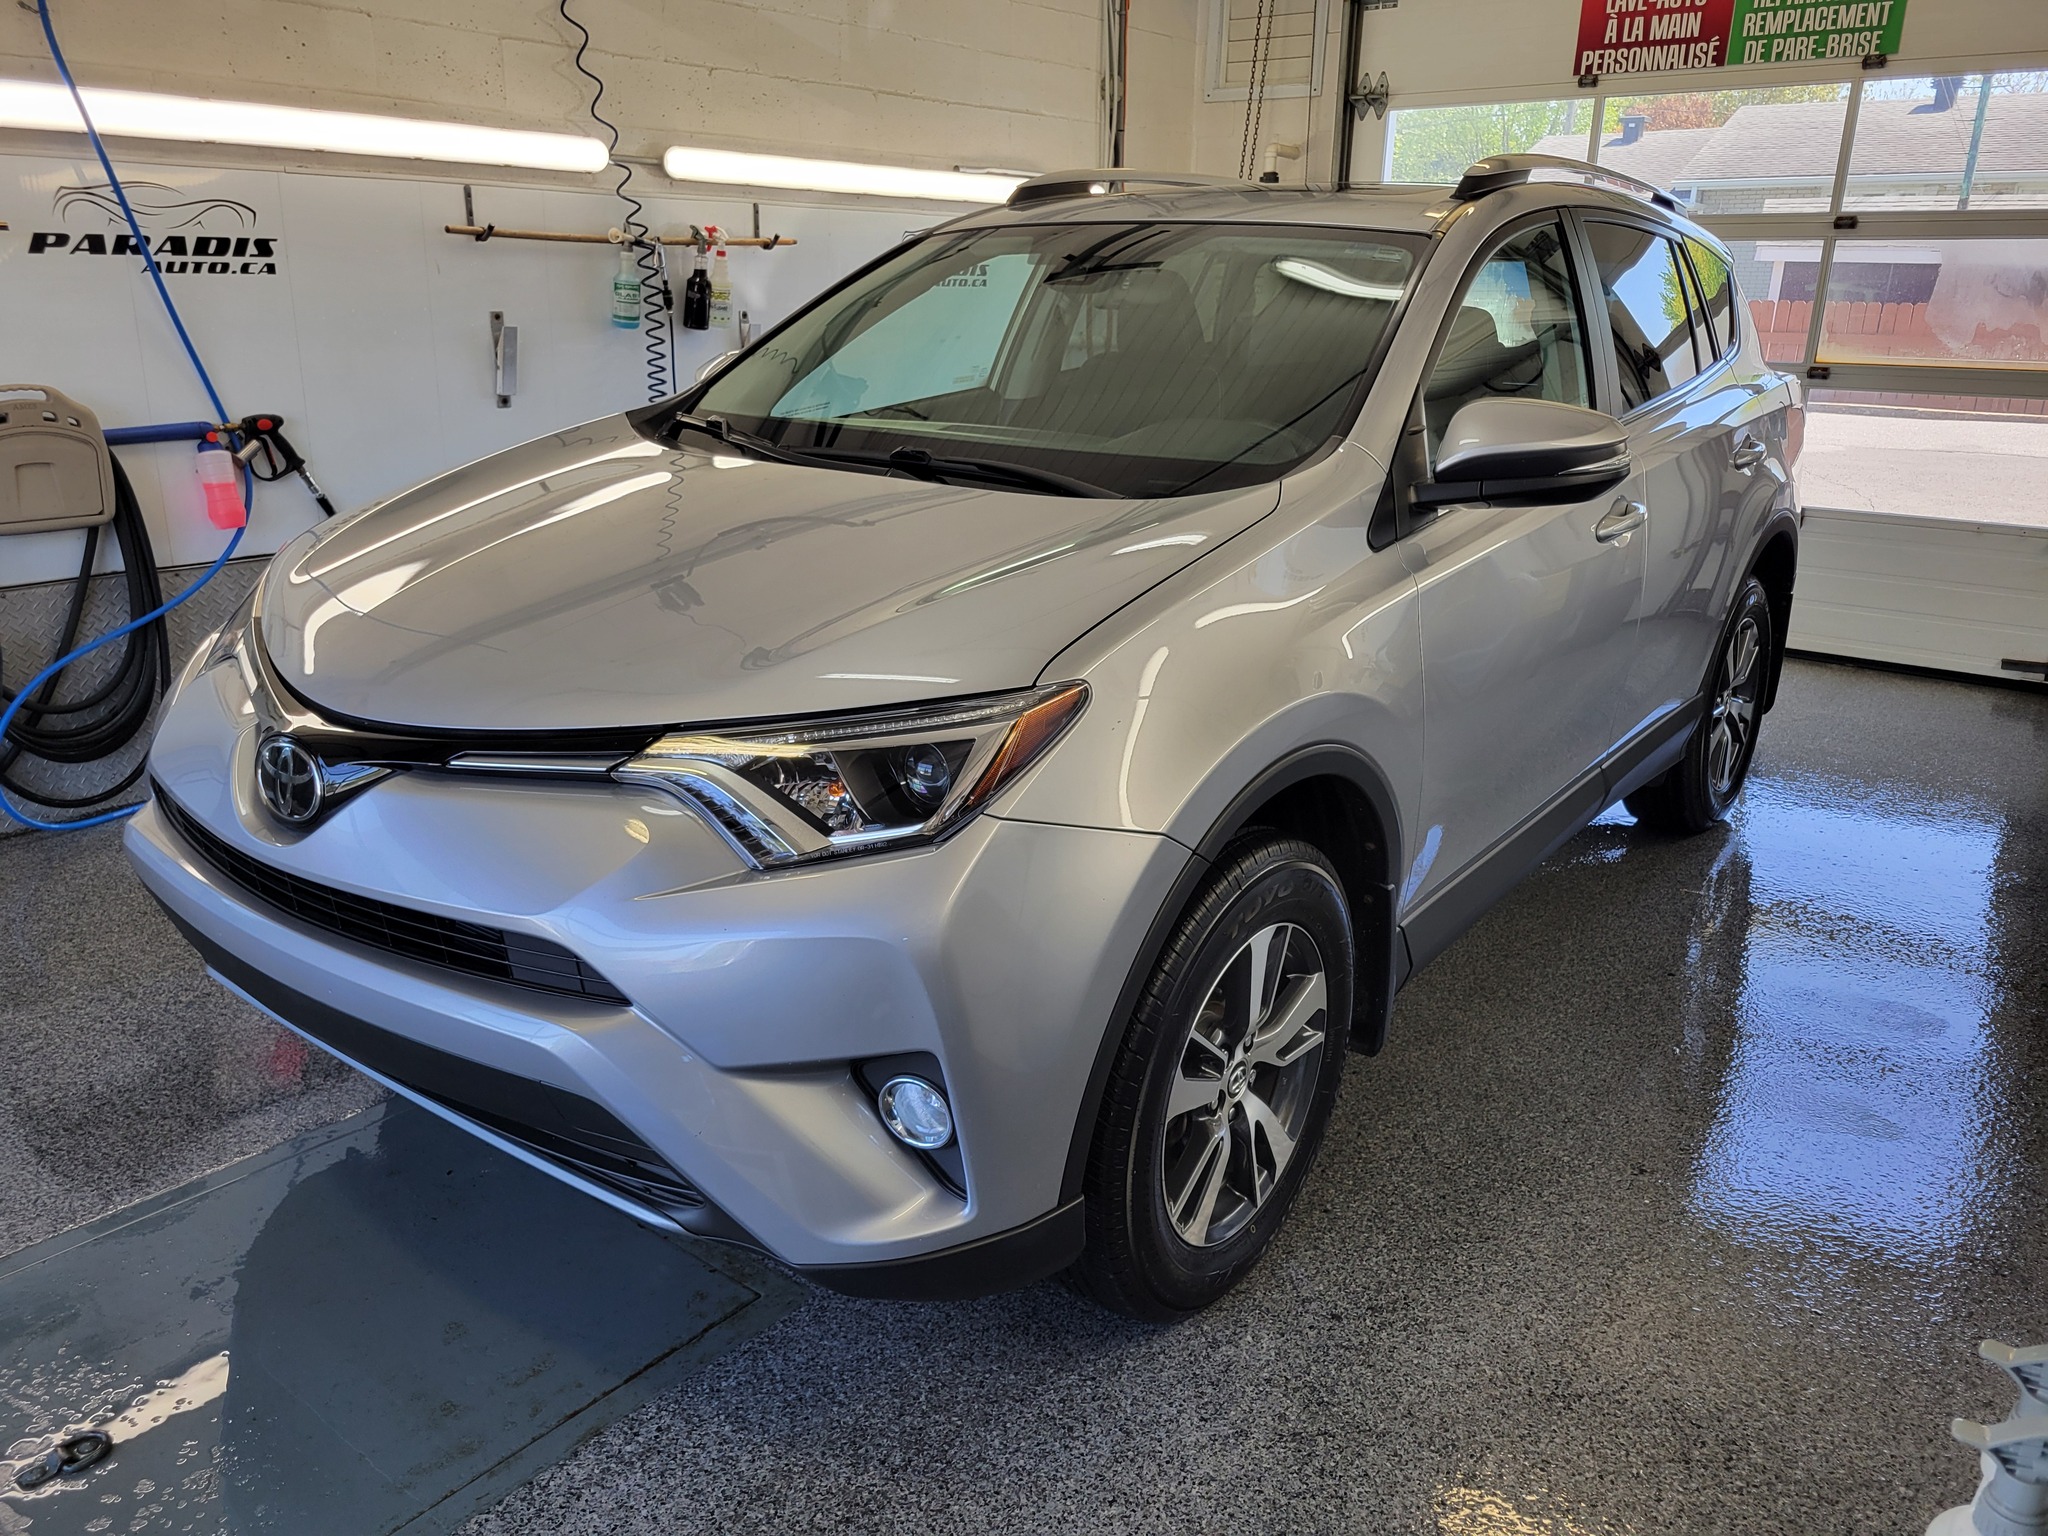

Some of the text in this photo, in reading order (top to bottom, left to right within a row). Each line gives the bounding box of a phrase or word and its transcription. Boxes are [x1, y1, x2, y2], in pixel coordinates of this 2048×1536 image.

[1604, 11, 1702, 44] À LA MAIN
[1742, 1, 1894, 37] REMPLACEMENT
[1580, 35, 1720, 75] PERSONNALISÉ
[1743, 30, 1884, 64] DE PARE-BRISE
[27, 232, 278, 258] PARADIS
[936, 278, 987, 287] UTO.CA
